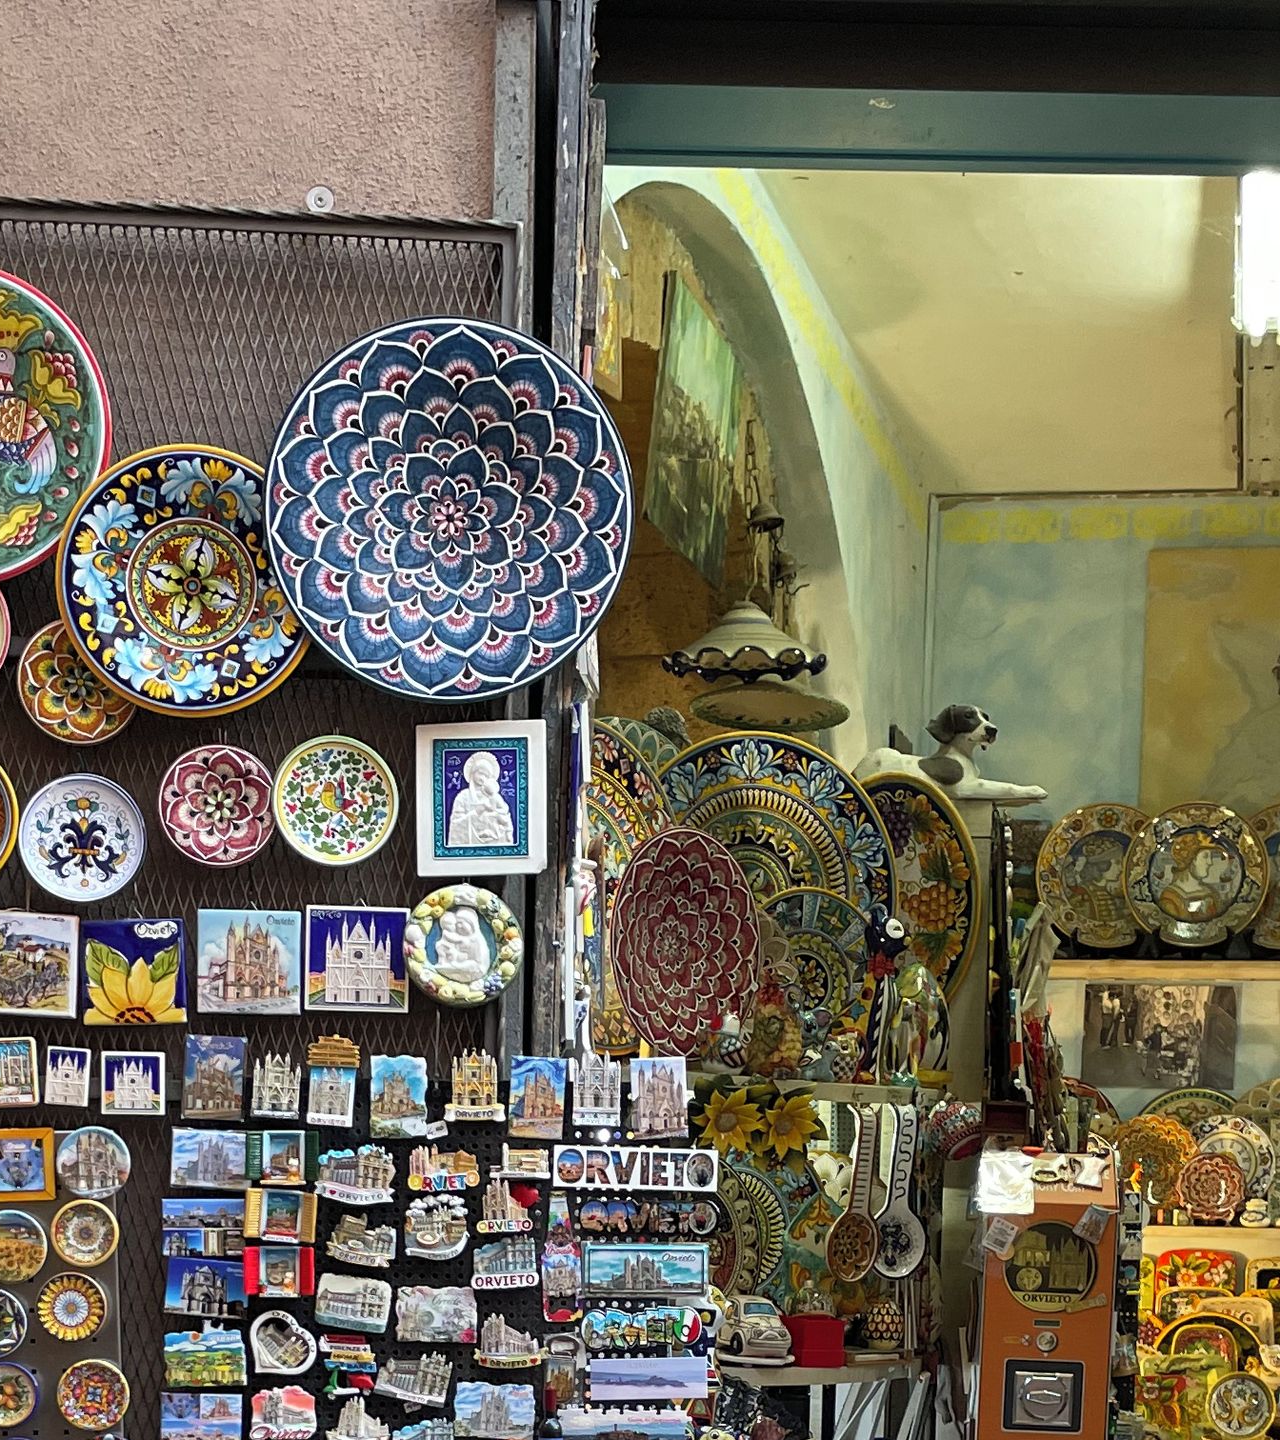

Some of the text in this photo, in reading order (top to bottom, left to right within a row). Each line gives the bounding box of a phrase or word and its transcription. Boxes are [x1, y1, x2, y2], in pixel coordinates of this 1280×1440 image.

[454, 1109, 494, 1119] ORVIETO
[557, 1148, 715, 1189] ORVIETO
[407, 1171, 480, 1193] ORVIETO
[338, 1191, 384, 1203] ORVIETO
[476, 1218, 533, 1234] ORVIETO
[660, 1251, 698, 1264] Orvieto
[474, 1274, 536, 1288] ORVIETO
[1022, 1293, 1072, 1304] ORVIETO
[489, 1359, 528, 1368] ORVIETO
